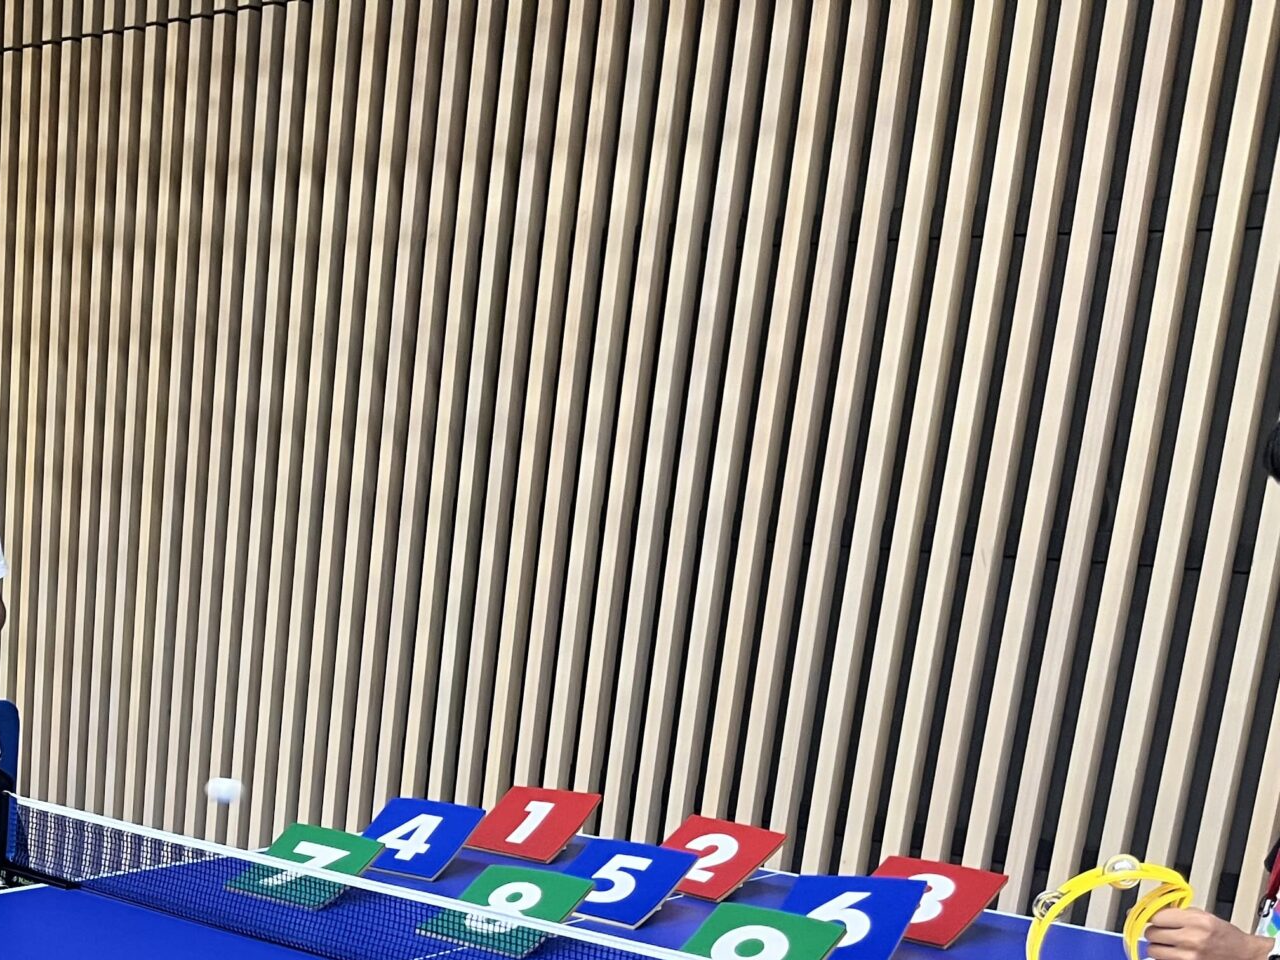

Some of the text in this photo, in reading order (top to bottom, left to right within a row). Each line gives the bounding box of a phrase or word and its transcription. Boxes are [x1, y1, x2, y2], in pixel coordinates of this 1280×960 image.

[376, 813, 444, 862] 4
[505, 800, 556, 844] 1
[259, 840, 351, 887] 7
[584, 853, 653, 904] 5
[684, 833, 740, 883] 2
[464, 881, 542, 934] 8
[806, 891, 872, 948] 6
[906, 873, 956, 924] 3
